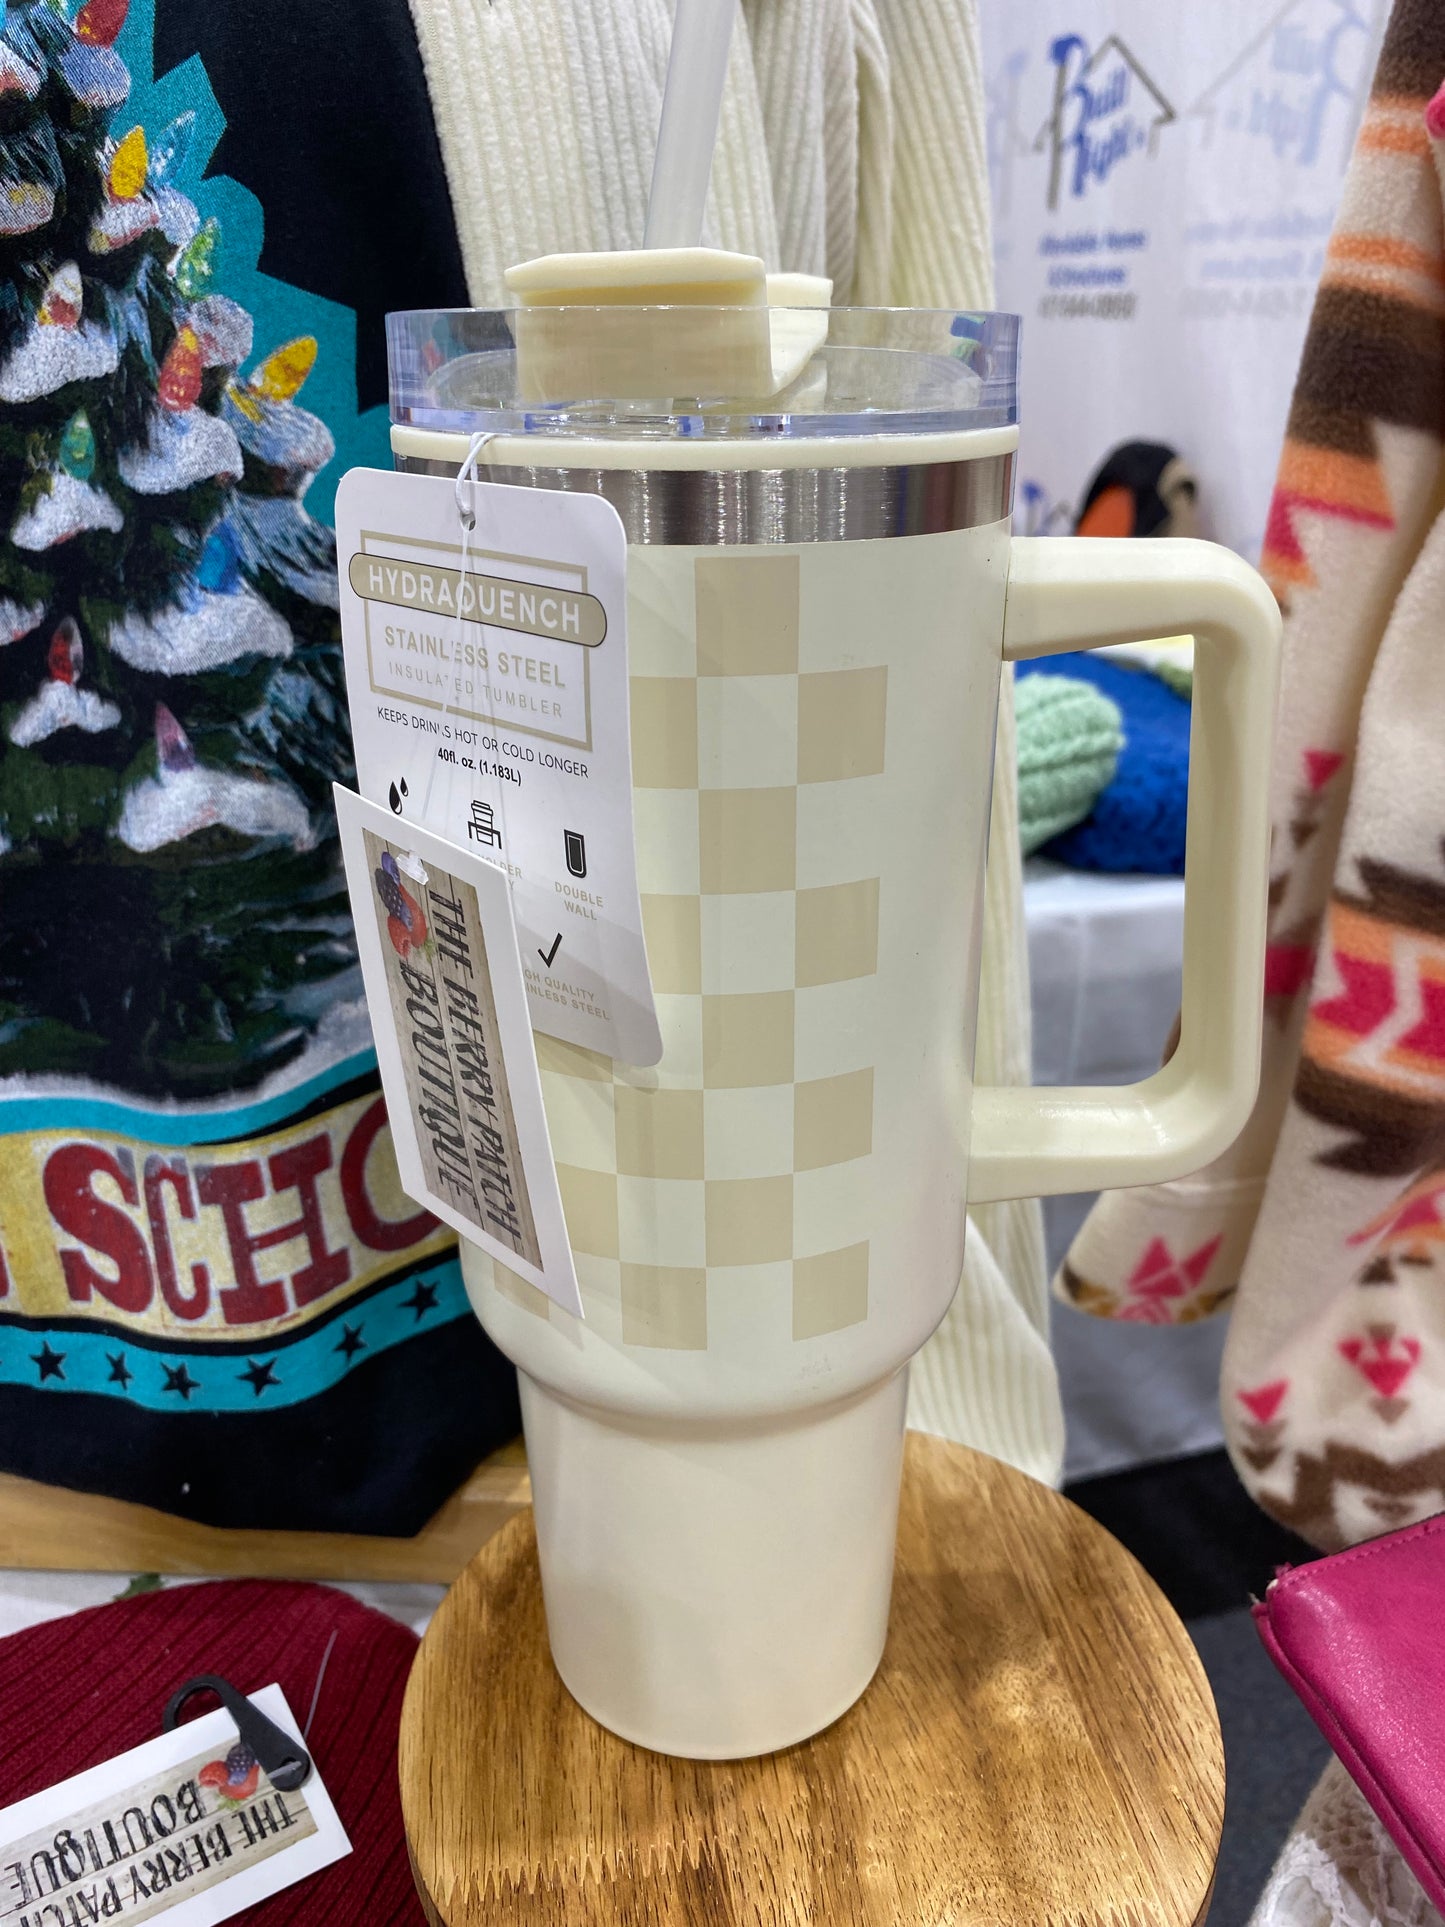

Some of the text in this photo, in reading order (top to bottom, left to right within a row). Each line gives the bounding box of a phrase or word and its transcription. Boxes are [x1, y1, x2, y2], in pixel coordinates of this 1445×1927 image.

[369, 565, 579, 634] HYDRAQUENCH
[385, 626, 566, 688] STAINLESS STEEL
[483, 684, 562, 718] TUMBLER
[377, 706, 589, 778] KEEPS DRINS HOT OR COLD LONGER
[437, 747, 522, 786] 40fl. oz. (1.183L)
[554, 881, 604, 908] DOUBLE
[564, 900, 598, 921] WALL
[524, 969, 594, 1002] GH QUALITY
[526, 983, 611, 1021] INLESS STEEL
[400, 960, 481, 1210] BOUTIQUE
[429, 890, 521, 1241] THE BERRY PATCH
[4, 1779, 207, 1909] BOUTIQUE
[231, 1792, 298, 1849] THE
[129, 1822, 233, 1904] BERRY
